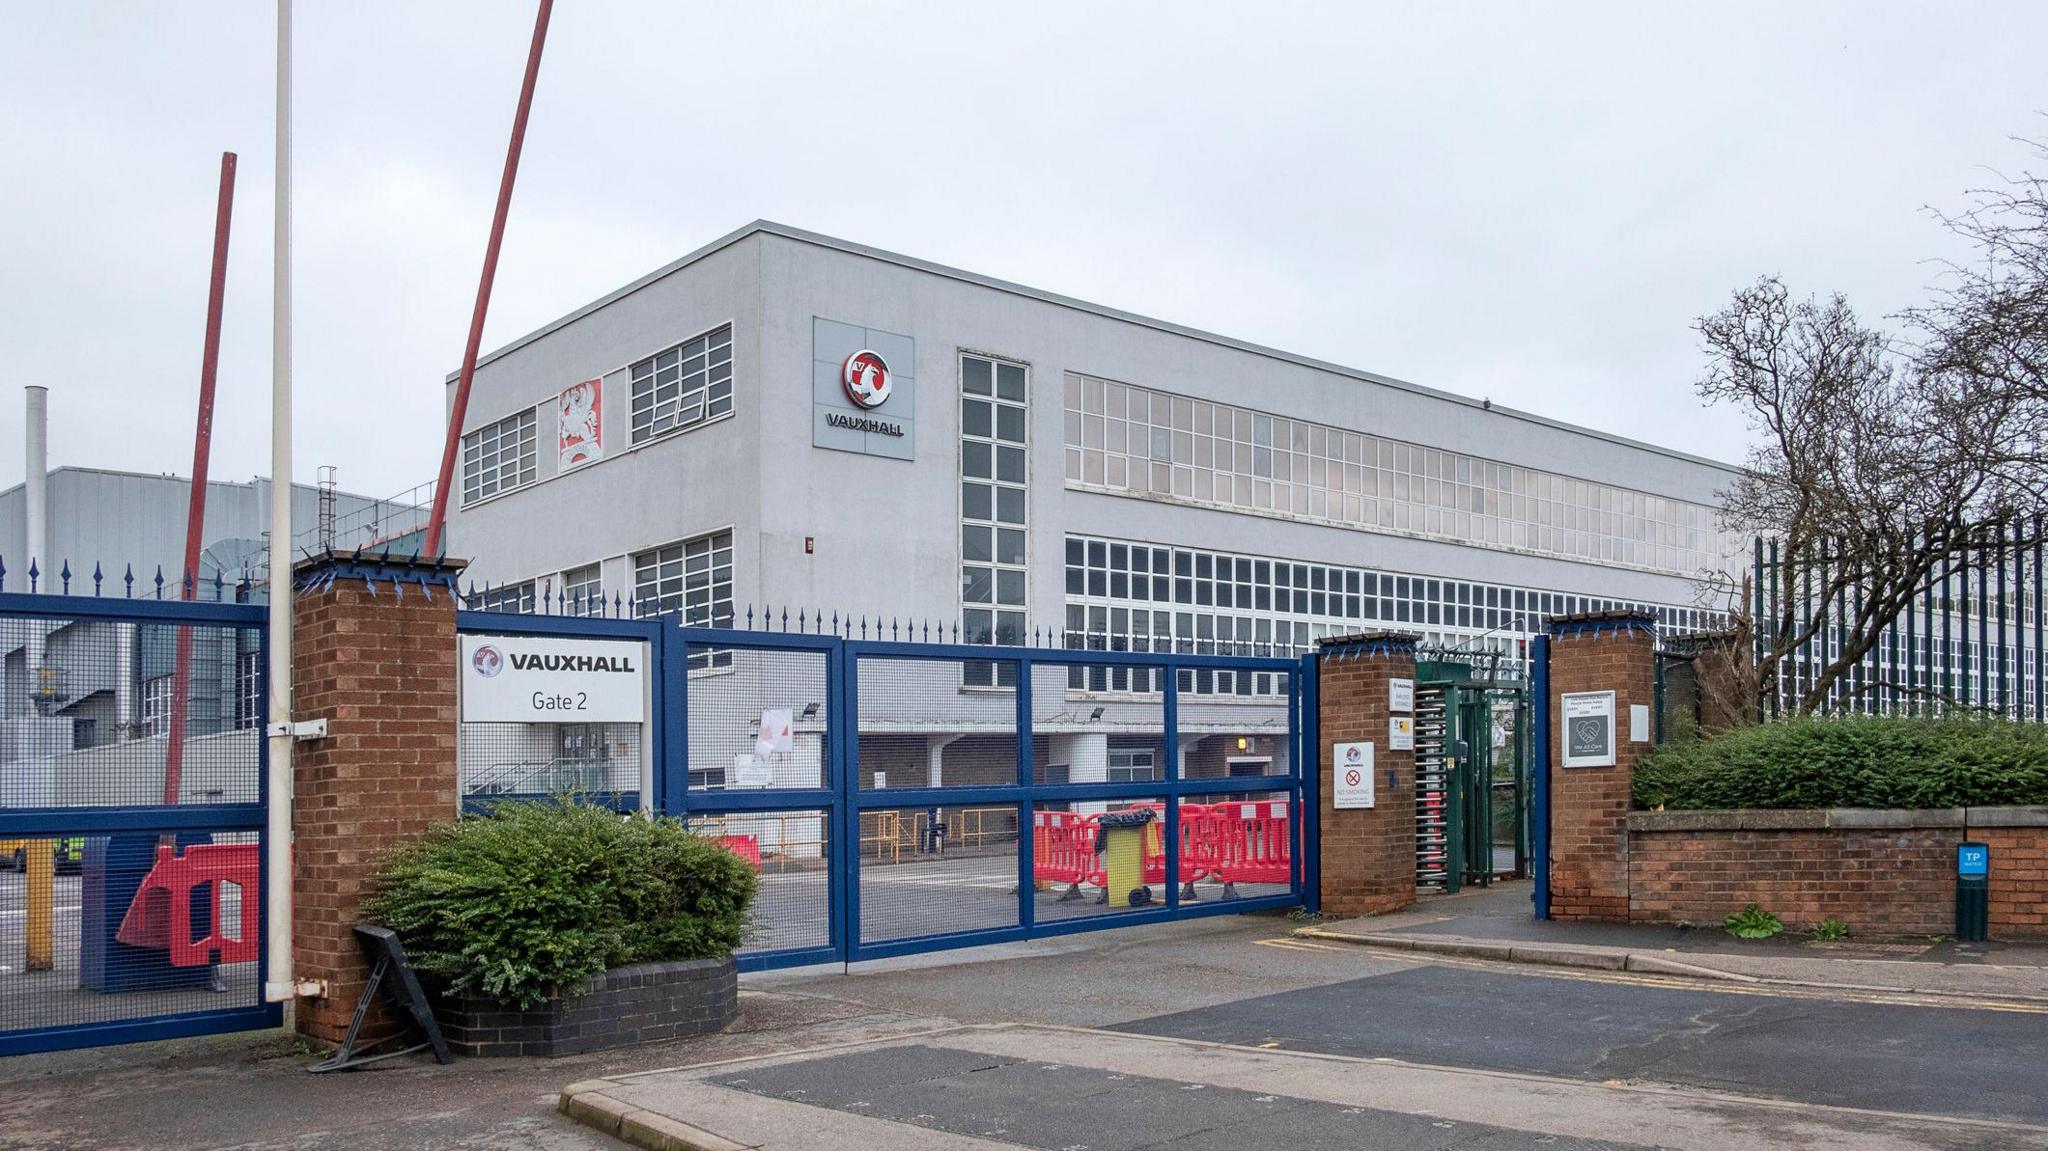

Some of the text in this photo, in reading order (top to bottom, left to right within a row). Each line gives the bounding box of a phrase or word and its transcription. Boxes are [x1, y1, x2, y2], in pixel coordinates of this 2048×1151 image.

[826, 413, 904, 437] VAUXHALL
[510, 653, 635, 673] VAUXHALL
[532, 691, 587, 710] Gate 2
[1966, 852, 1981, 861] TP
